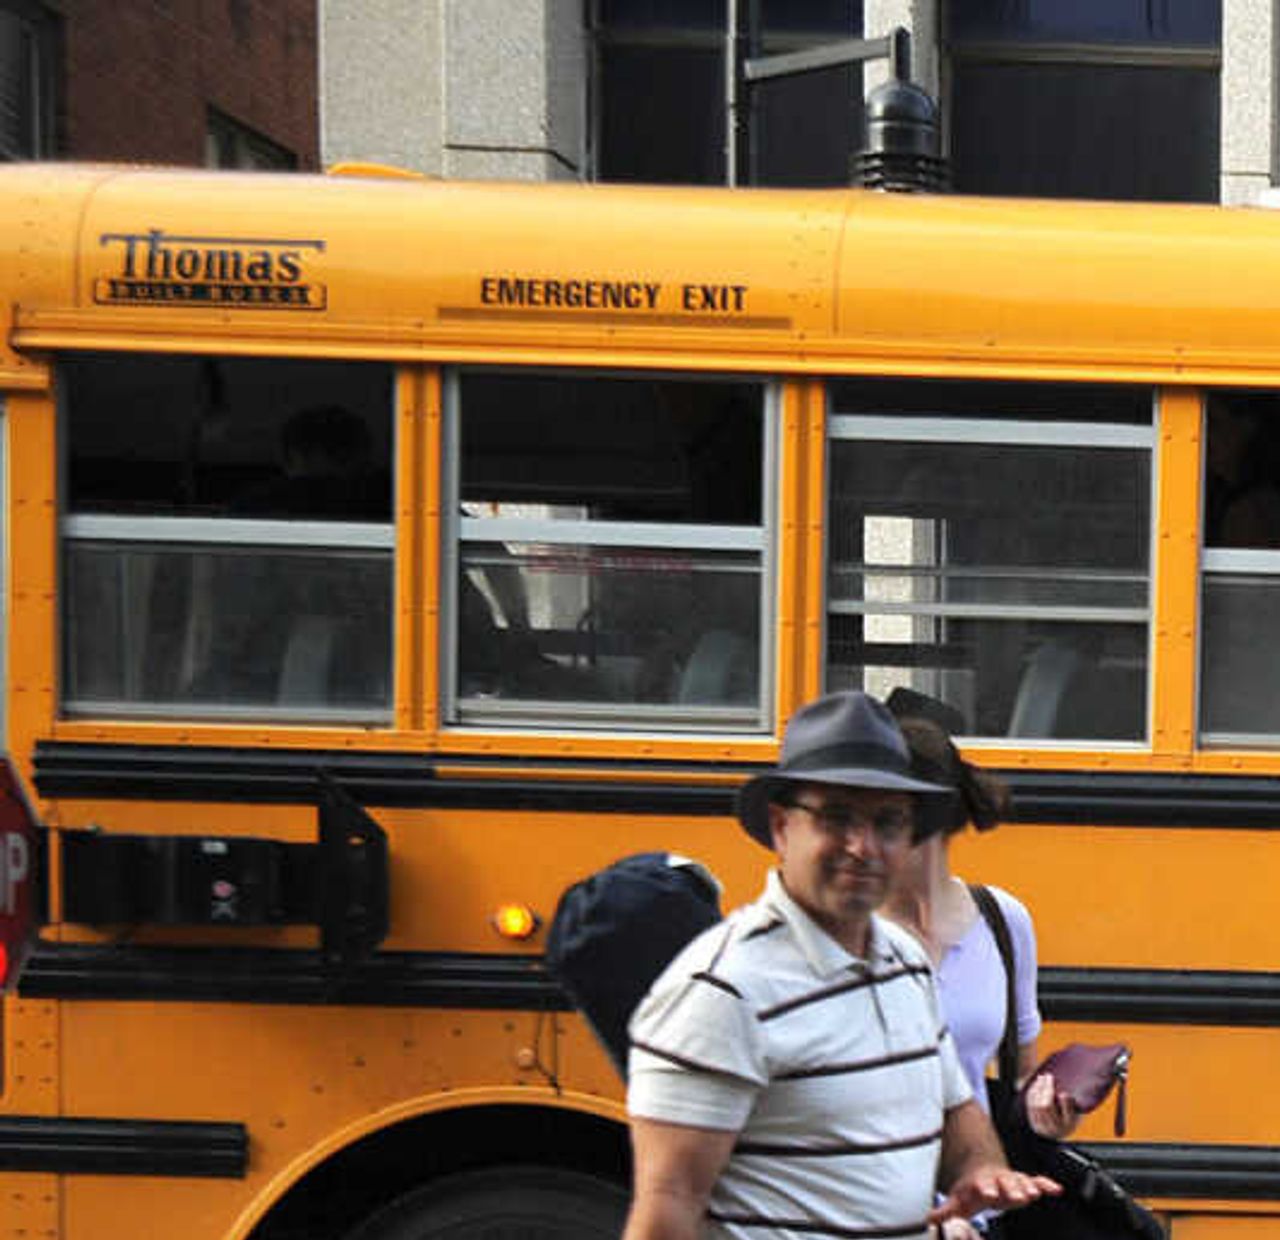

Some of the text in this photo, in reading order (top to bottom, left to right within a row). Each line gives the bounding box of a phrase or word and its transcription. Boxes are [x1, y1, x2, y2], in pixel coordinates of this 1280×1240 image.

[100, 230, 323, 281] Thomas
[480, 278, 747, 311] EMERGENCY EXIT
